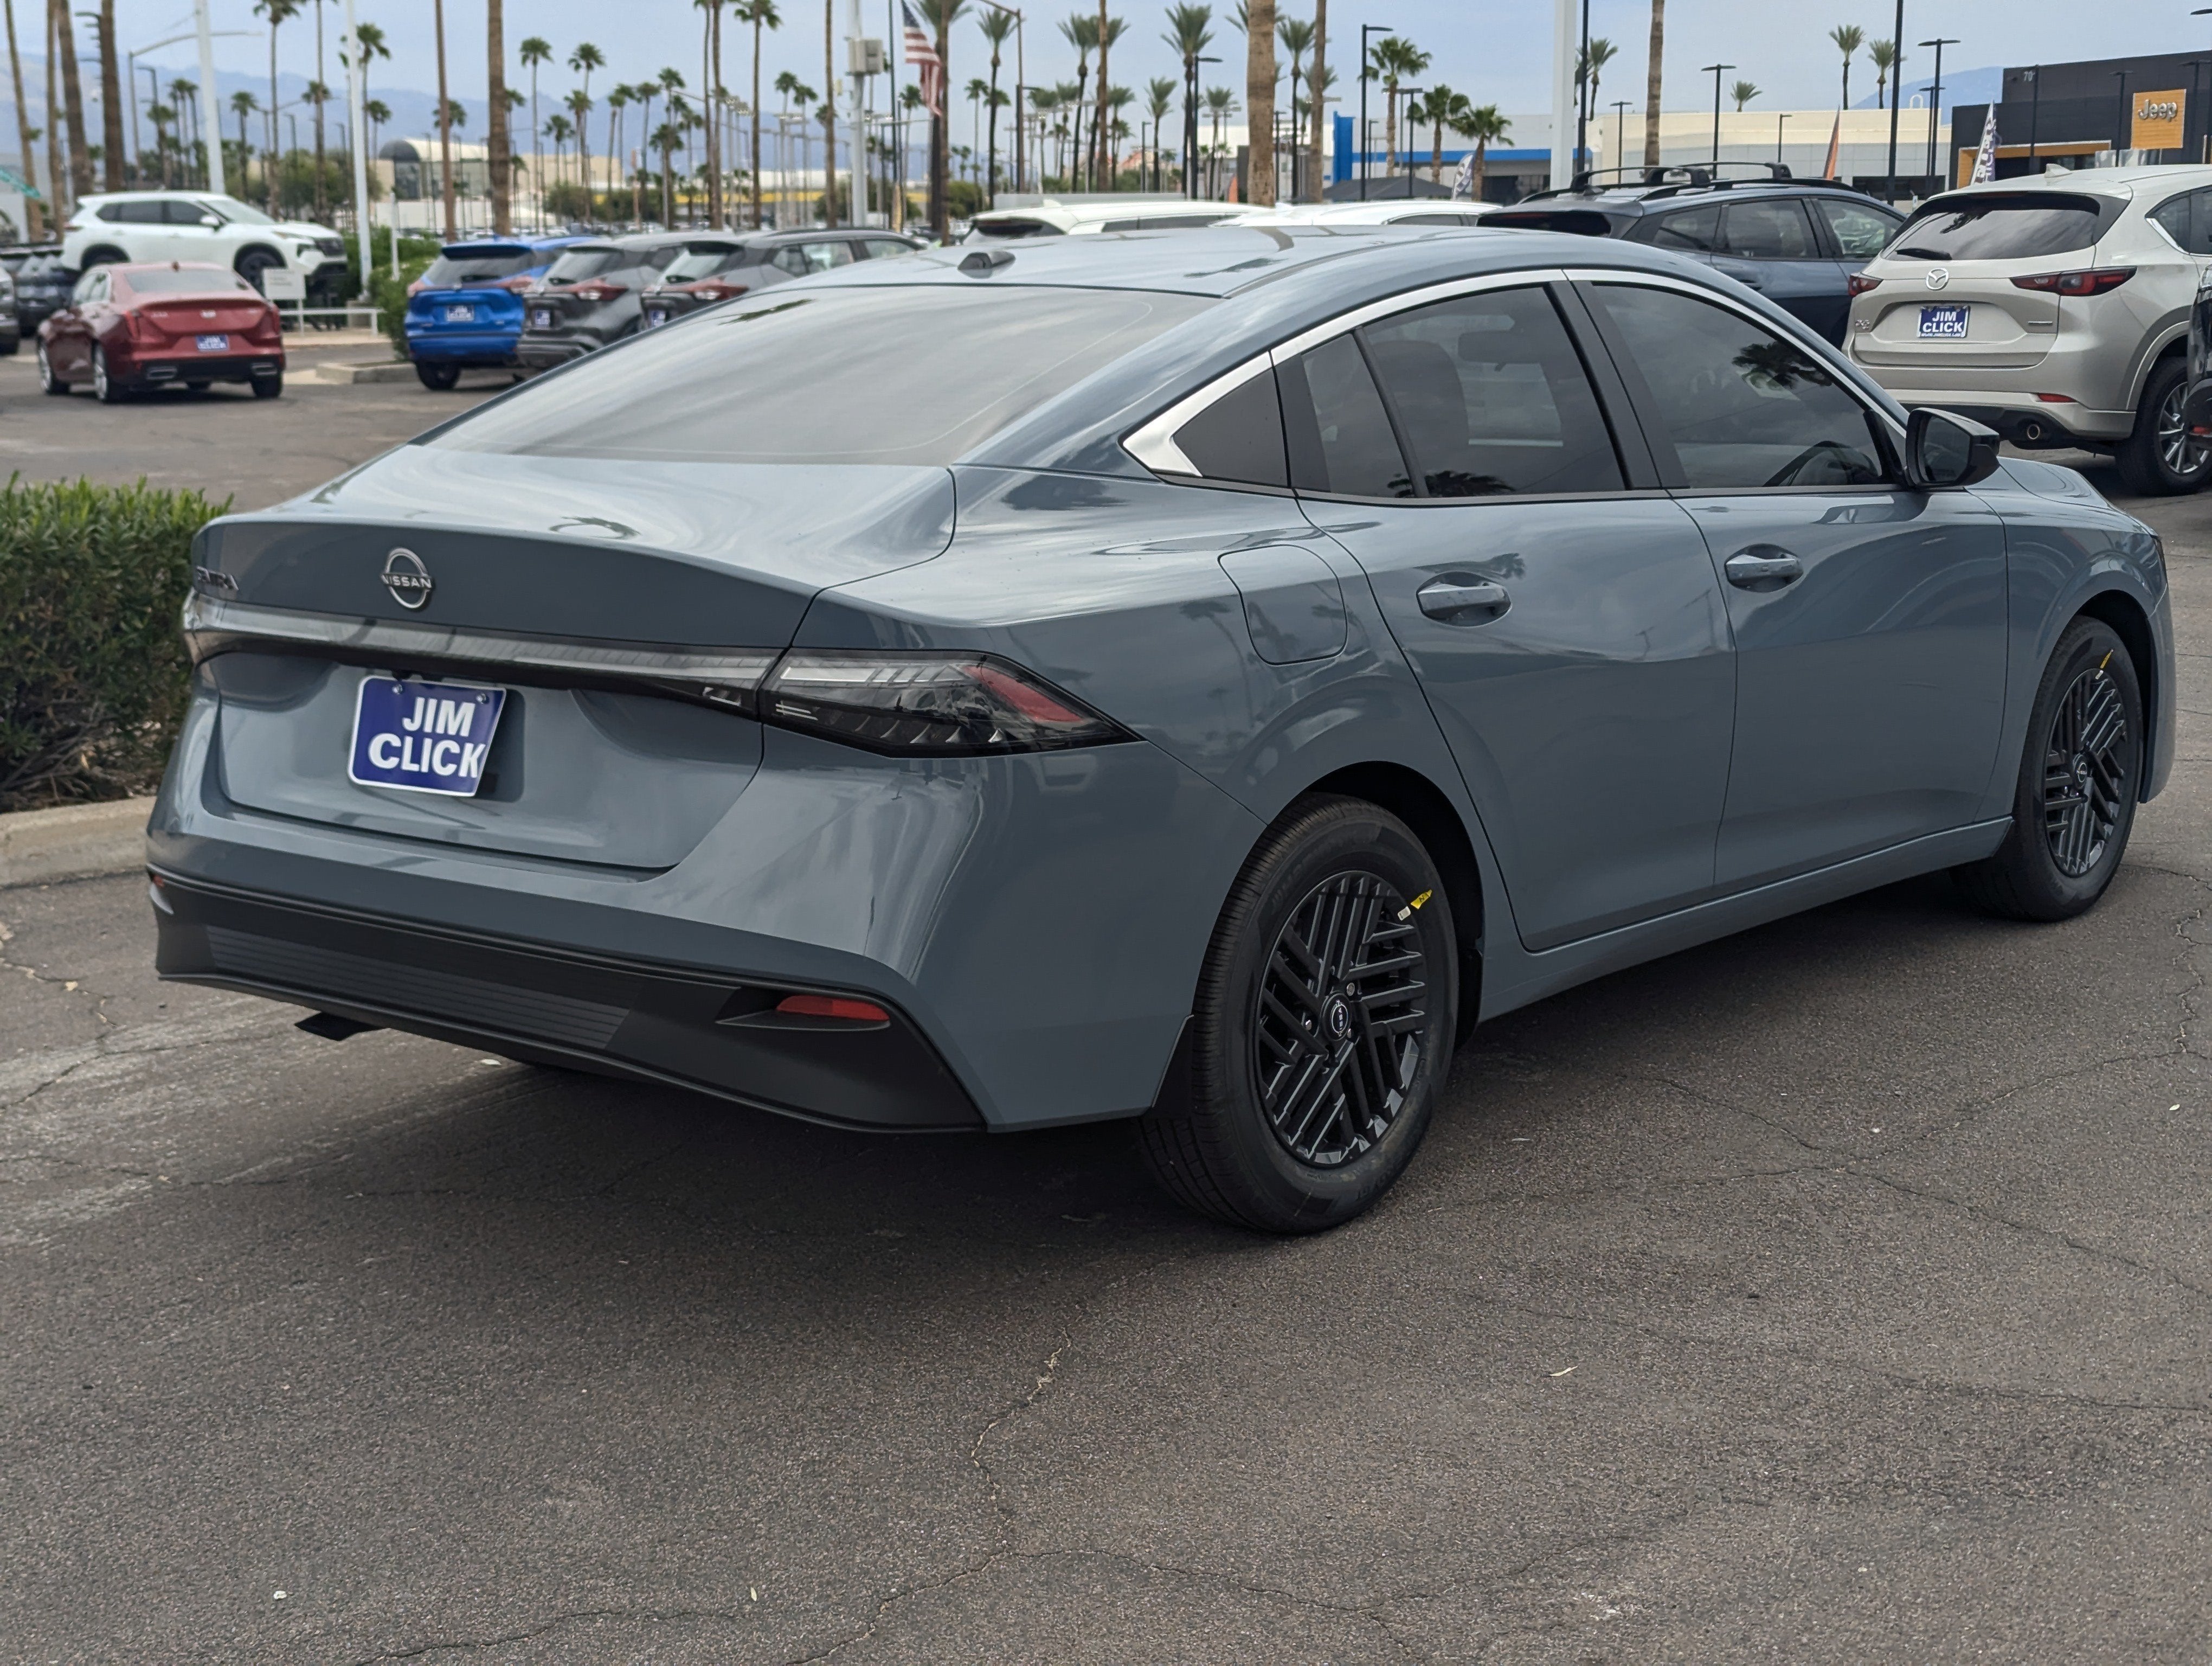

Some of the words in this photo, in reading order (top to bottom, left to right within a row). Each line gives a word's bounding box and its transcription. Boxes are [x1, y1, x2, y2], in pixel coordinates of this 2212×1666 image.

[2138, 99, 2177, 122] Jeep
[1932, 311, 1957, 322] JIM
[1922, 322, 1963, 332] CLICK
[381, 575, 432, 588] NISSAN
[402, 697, 476, 738] JIM
[368, 733, 486, 779] CLICK
